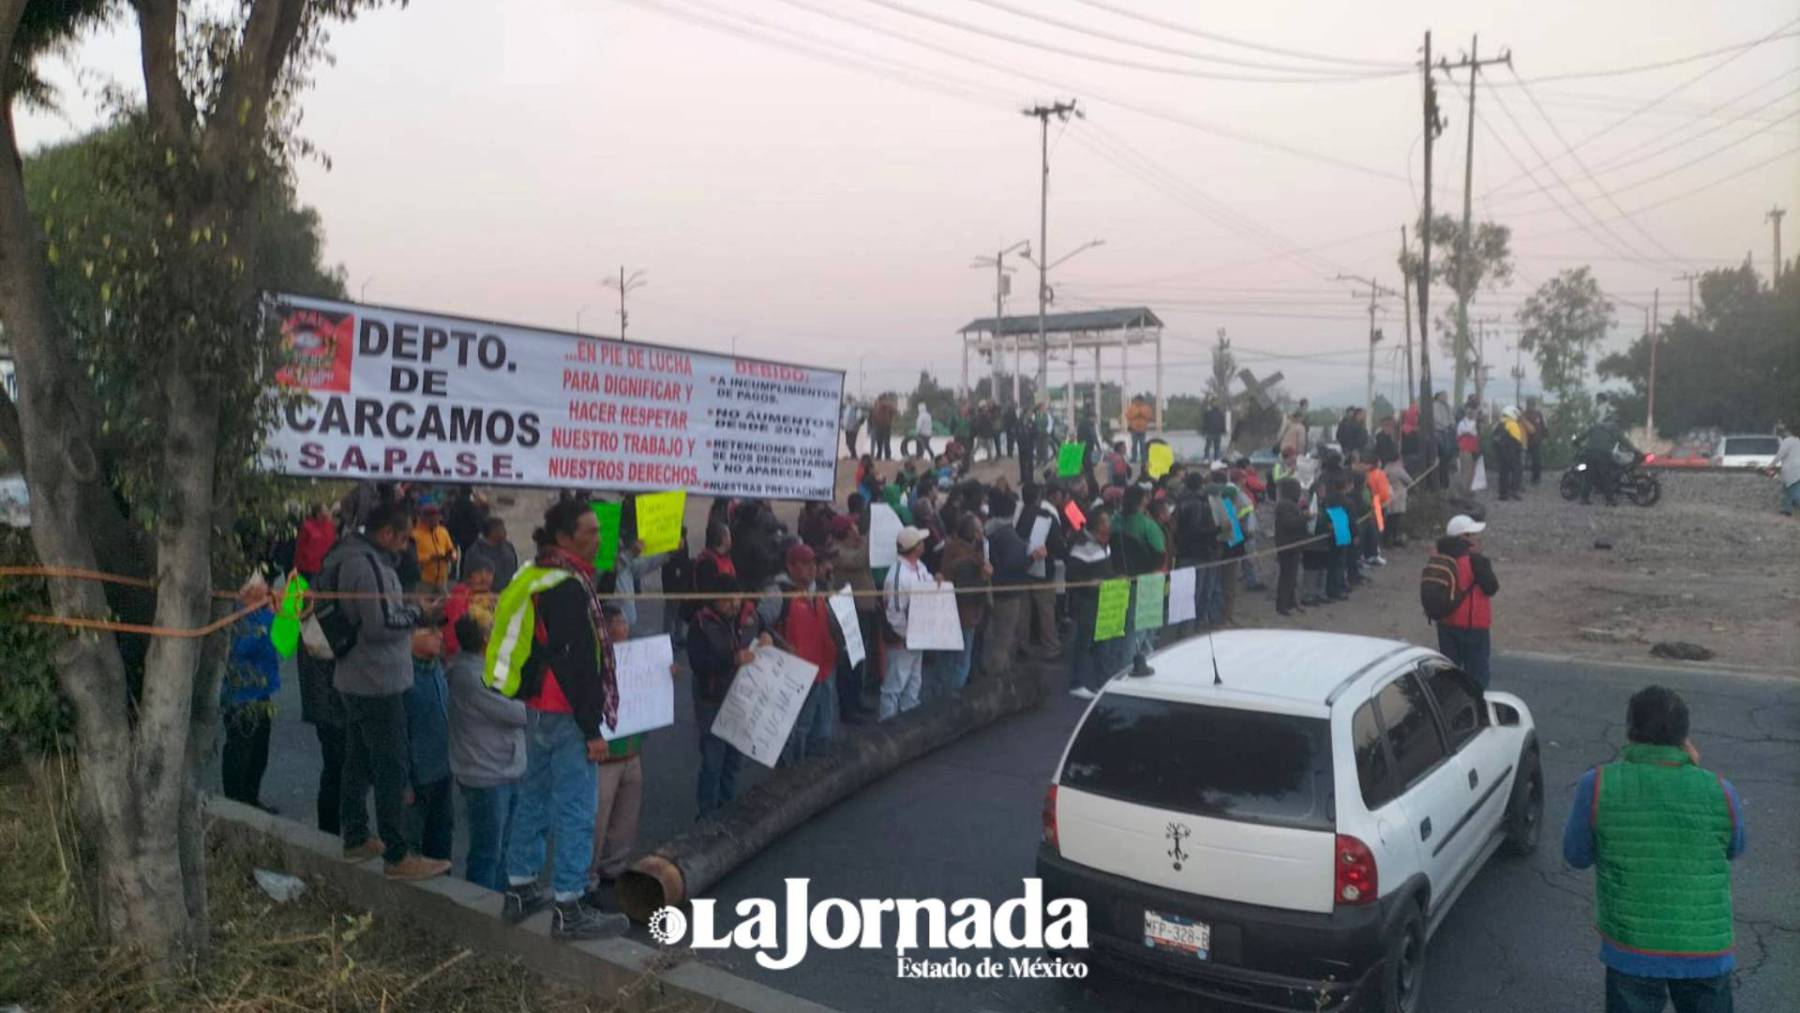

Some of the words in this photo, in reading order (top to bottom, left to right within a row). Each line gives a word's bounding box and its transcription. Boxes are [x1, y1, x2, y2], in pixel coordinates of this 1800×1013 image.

[358, 317, 517, 373] DEPTO.
[601, 344, 622, 365] PIE
[628, 348, 644, 368] DE
[649, 352, 693, 375] LUCHA
[389, 366, 448, 397] DE
[562, 369, 599, 392] PARA
[604, 374, 681, 402] DIGNIFICAR
[685, 384, 694, 403] Y
[716, 388, 732, 399] DE
[717, 376, 726, 386] A
[730, 379, 838, 398] INCUMPLIMIENTOS
[284, 396, 541, 448] CARCAMOS
[568, 400, 617, 423] HACER
[621, 405, 688, 429] RESPETAR
[714, 420, 769, 433] DESDE
[715, 407, 740, 419] NO
[745, 410, 835, 428] AUMENTOS
[551, 427, 619, 452] NUESTRO
[623, 433, 684, 457] TRABAJO
[688, 439, 696, 457] Y
[713, 440, 796, 455] RETENCIONES
[799, 446, 825, 458] QUE
[298, 442, 524, 480] S.A.P.A.S.E.
[548, 458, 625, 481] NUESTROS
[712, 450, 727, 460] SE
[729, 452, 754, 463] NOS
[756, 454, 834, 470] DESCONTARON
[712, 462, 720, 473] Y
[723, 463, 743, 475] NO
